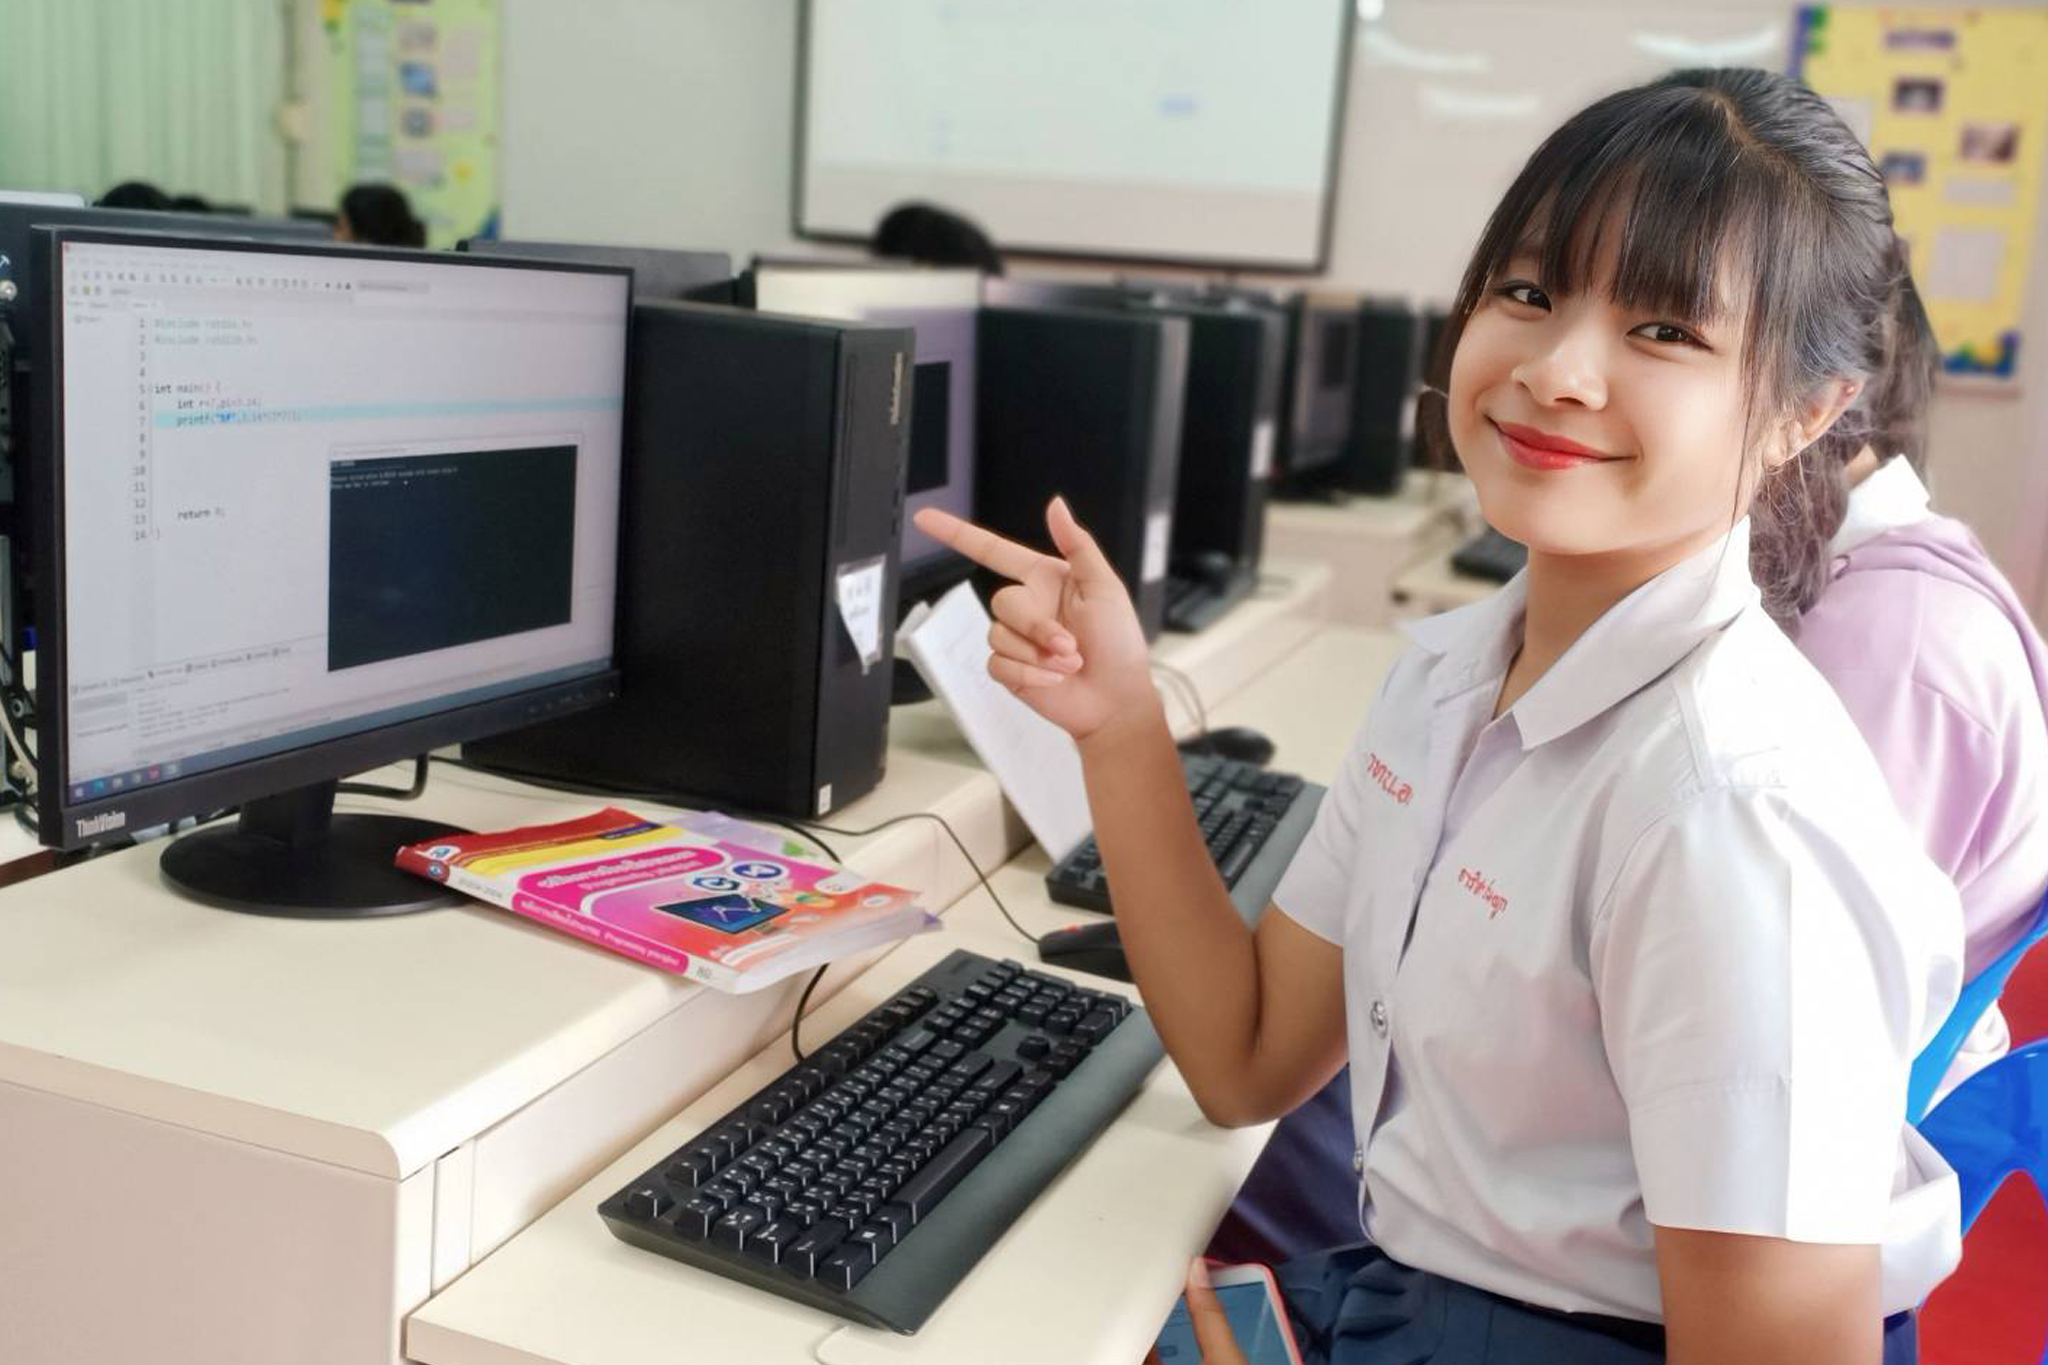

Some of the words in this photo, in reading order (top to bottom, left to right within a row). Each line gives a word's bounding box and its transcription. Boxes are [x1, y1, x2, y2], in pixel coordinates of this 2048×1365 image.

[154, 382, 172, 394] int
[177, 398, 195, 411] int
[134, 465, 146, 476] 10
[134, 482, 146, 493] 11
[134, 498, 146, 509] 12
[177, 506, 211, 521] return
[76, 811, 126, 839] ThinkVision
